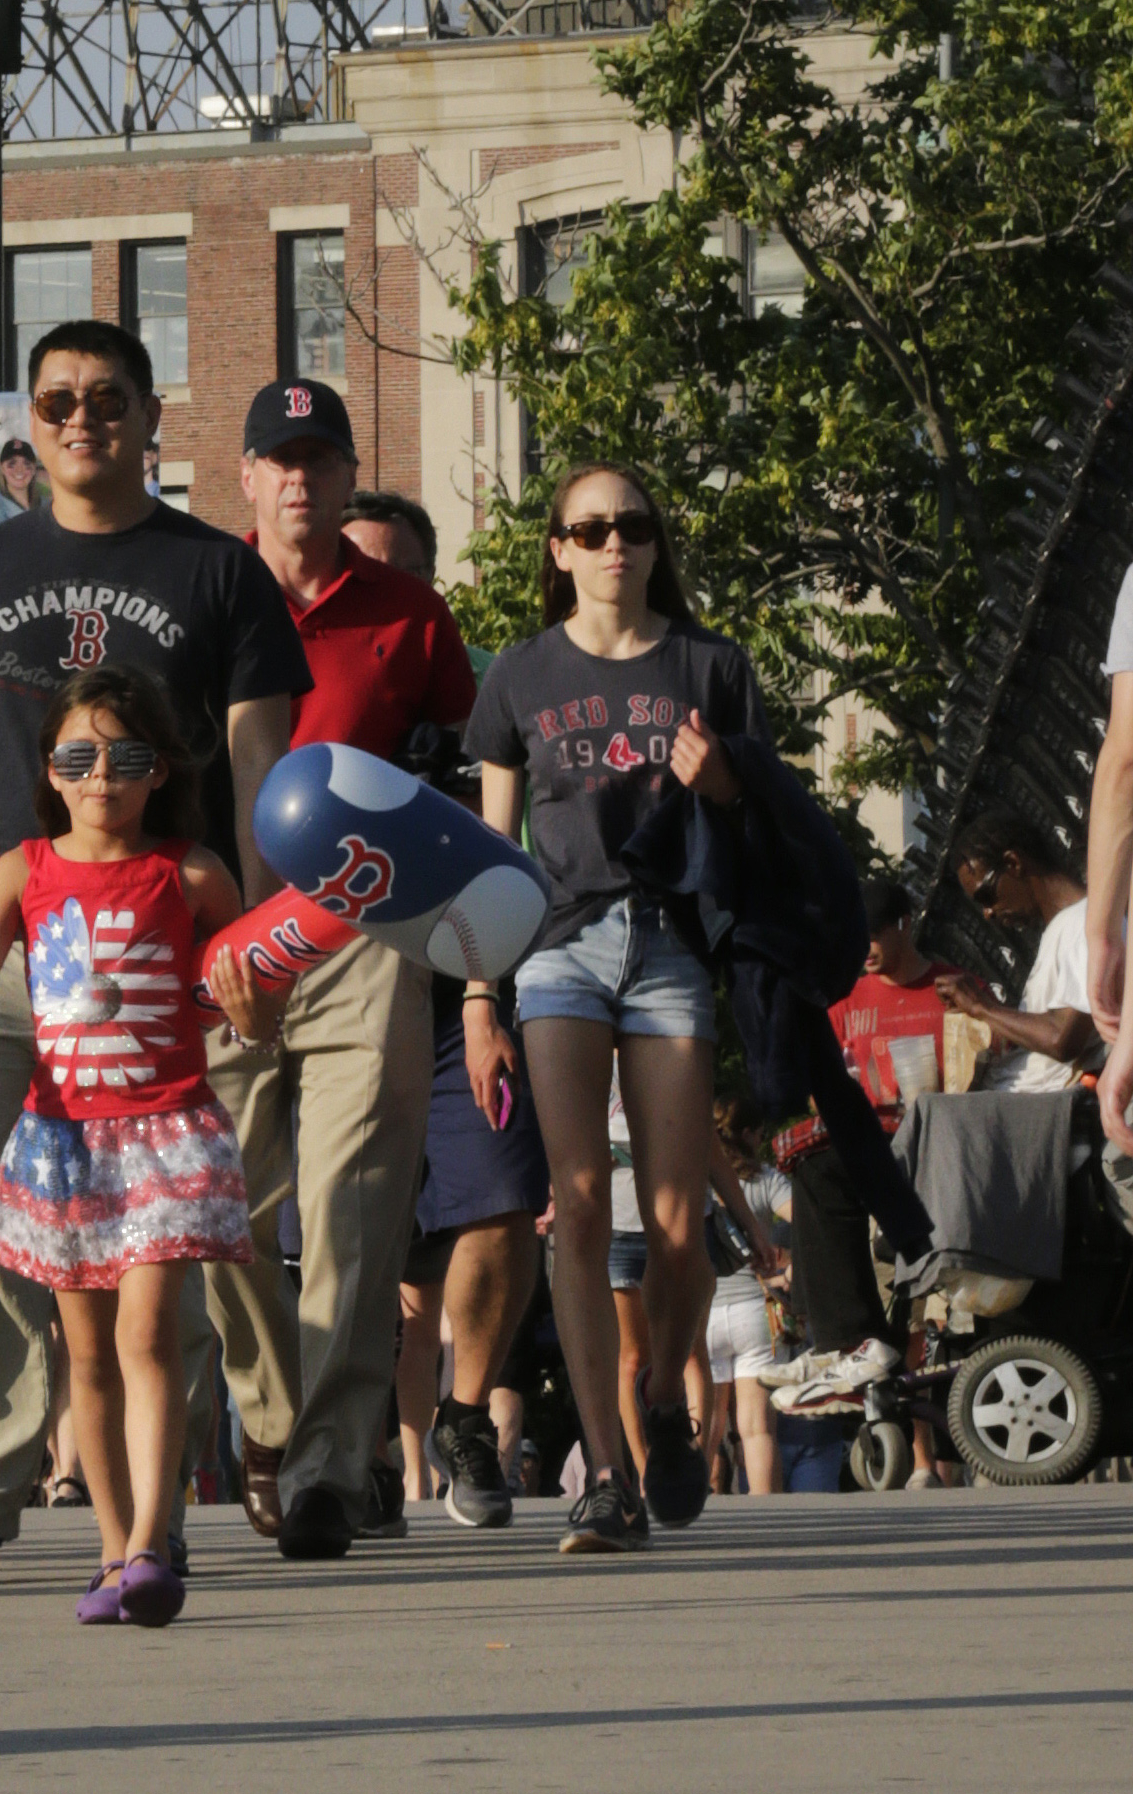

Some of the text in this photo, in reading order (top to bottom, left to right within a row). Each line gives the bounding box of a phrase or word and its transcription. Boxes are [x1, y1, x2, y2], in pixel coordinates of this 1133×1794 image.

[284, 387, 312, 418] B
[59, 609, 110, 670] B
[535, 695, 609, 742] RED
[557, 738, 595, 770] 19
